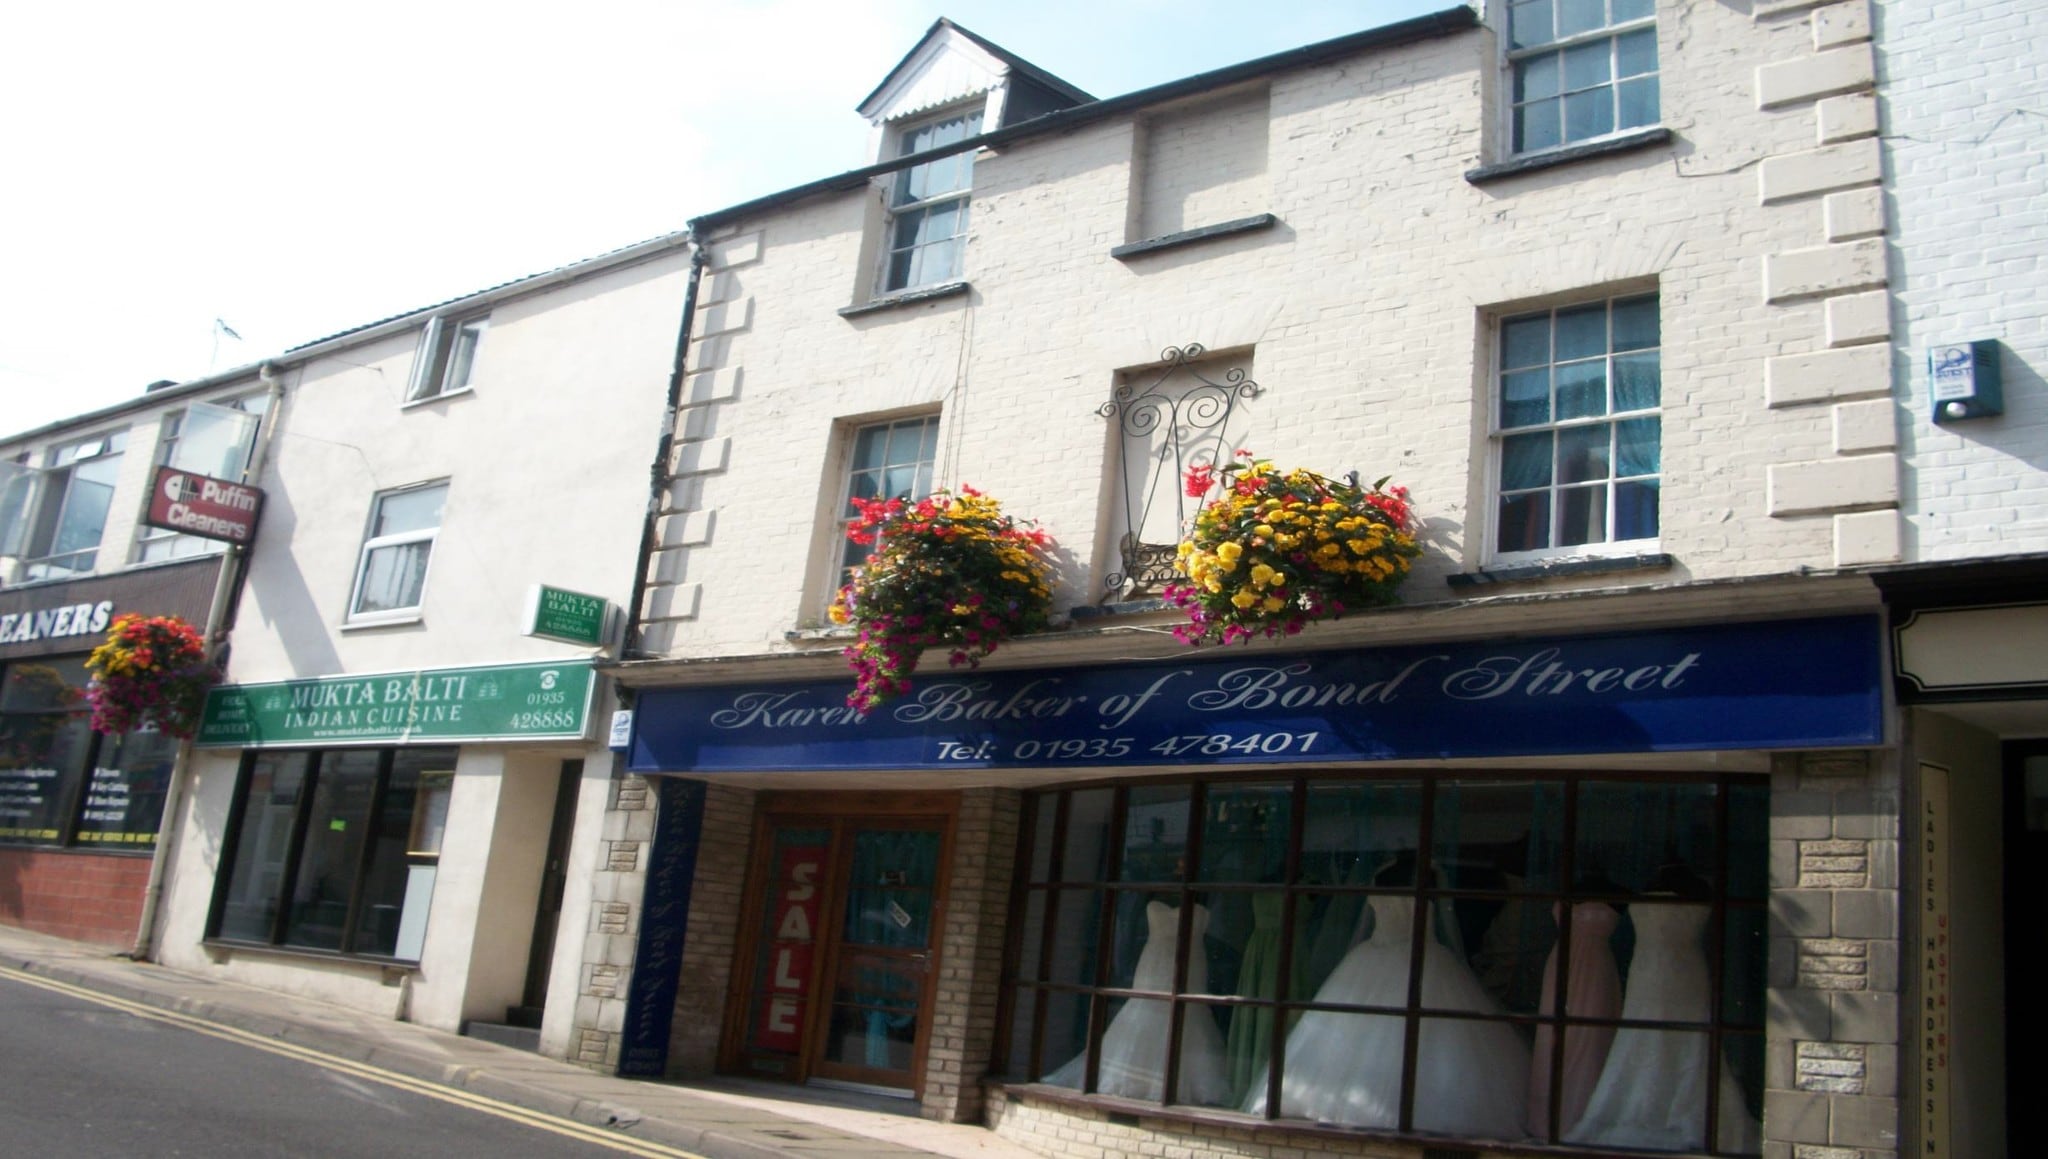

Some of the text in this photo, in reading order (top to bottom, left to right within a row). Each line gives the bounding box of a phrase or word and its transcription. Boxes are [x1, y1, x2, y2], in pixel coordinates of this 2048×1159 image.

[201, 480, 256, 511] Puffin
[167, 503, 247, 538] Cleaners
[546, 590, 598, 609] MUKTA
[548, 600, 594, 617] BALTI
[289, 675, 467, 709] MUKTA BALTI
[527, 692, 564, 705] 01935
[710, 647, 1702, 729] Karen Baker of Bond Street
[284, 705, 462, 728] INDIAN CUISINE
[509, 708, 574, 729] 428888
[314, 725, 422, 738] www.muktabalti.couk
[937, 732, 1319, 760] Tel: 01935 478401
[1926, 801, 1935, 911] LADIES
[769, 863, 818, 1034] SALE
[1938, 915, 1948, 1068] UPSTAIRS
